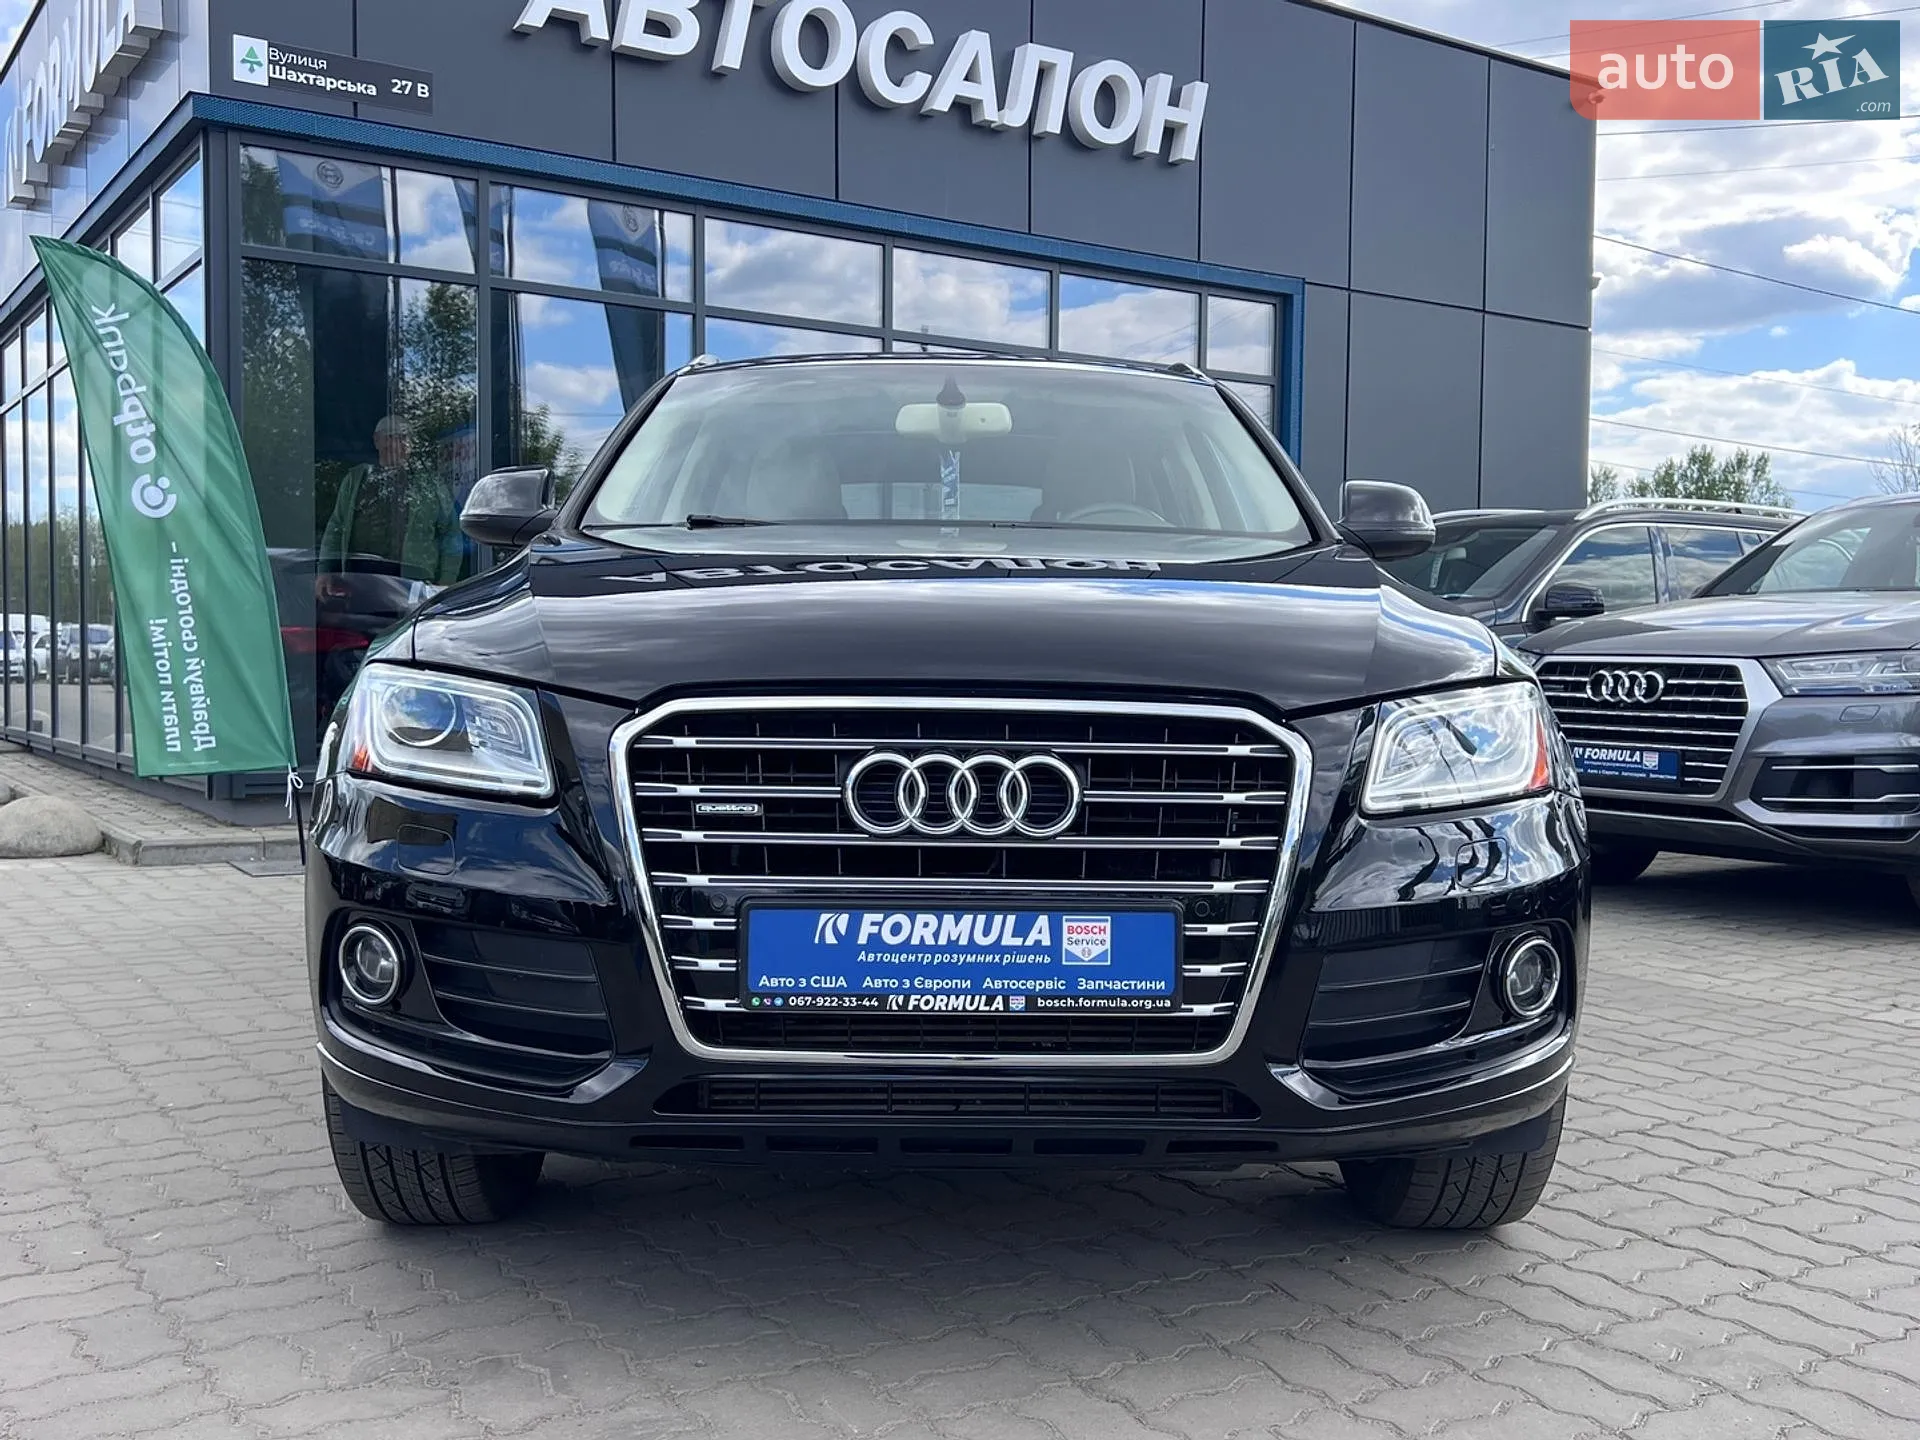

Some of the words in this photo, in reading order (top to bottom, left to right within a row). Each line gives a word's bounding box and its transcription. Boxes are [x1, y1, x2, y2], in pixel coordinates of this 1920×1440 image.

[269, 47, 328, 71] Вулиця
[269, 64, 378, 97] Шахтарська
[390, 78, 413, 96] 27
[1584, 747, 1641, 763] FORMULA
[857, 913, 1051, 946] FORMULA
[1066, 925, 1107, 935] BOSCH
[1066, 936, 1107, 946] Service
[857, 950, 932, 965] Автоцентр
[933, 953, 1000, 966] розумних
[1002, 951, 1052, 966] рішень
[758, 974, 795, 989] Авто
[798, 978, 807, 988] з
[810, 976, 848, 989] США
[862, 976, 899, 989] Авто
[902, 979, 910, 989] з
[914, 977, 971, 992] Європи
[983, 977, 1066, 992] Автосервіс
[1077, 978, 1166, 991] Запчастини
[788, 996, 879, 1008] 067-922-33-44
[907, 994, 1004, 1011] FORMULA
[1037, 997, 1171, 1009] bosch.formula.org.ua
